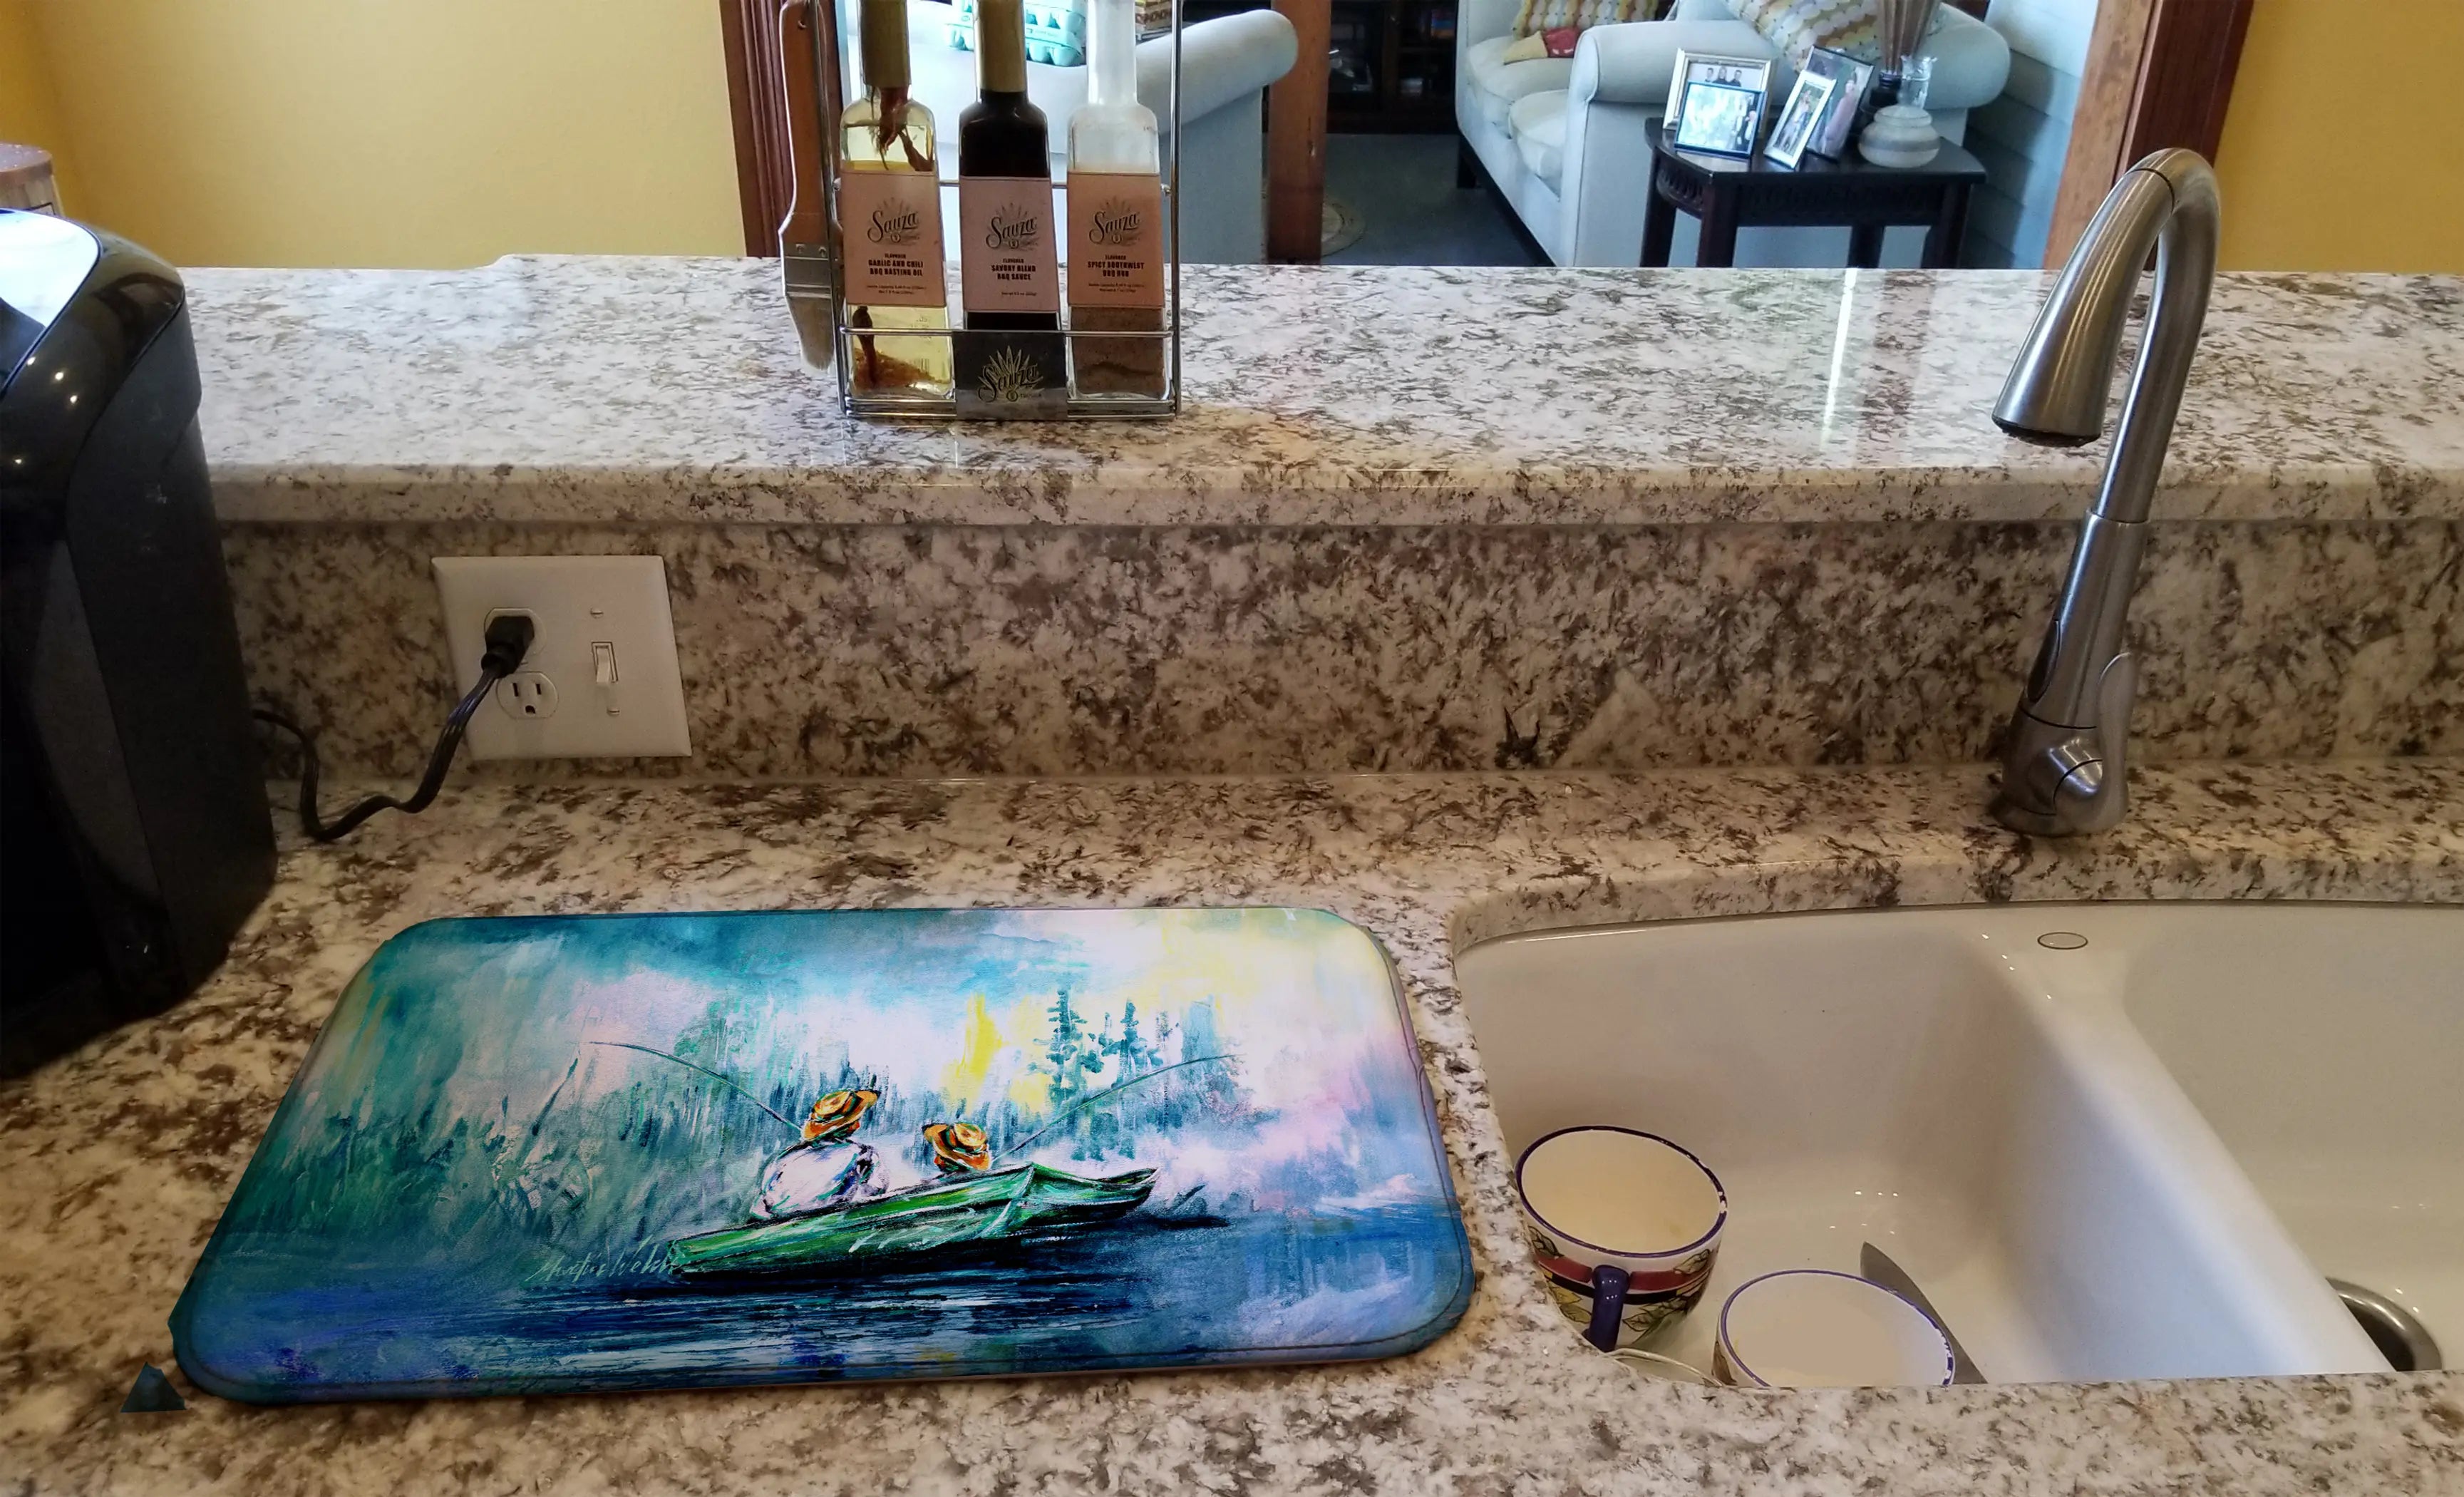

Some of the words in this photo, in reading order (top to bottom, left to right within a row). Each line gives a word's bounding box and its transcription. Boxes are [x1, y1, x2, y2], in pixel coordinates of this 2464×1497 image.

[867, 210, 919, 242] Sauza
[986, 216, 1038, 249] Sauza
[1089, 211, 1140, 244] Sauza
[885, 268, 912, 277] BASTING
[978, 364, 1039, 403] Sauza
